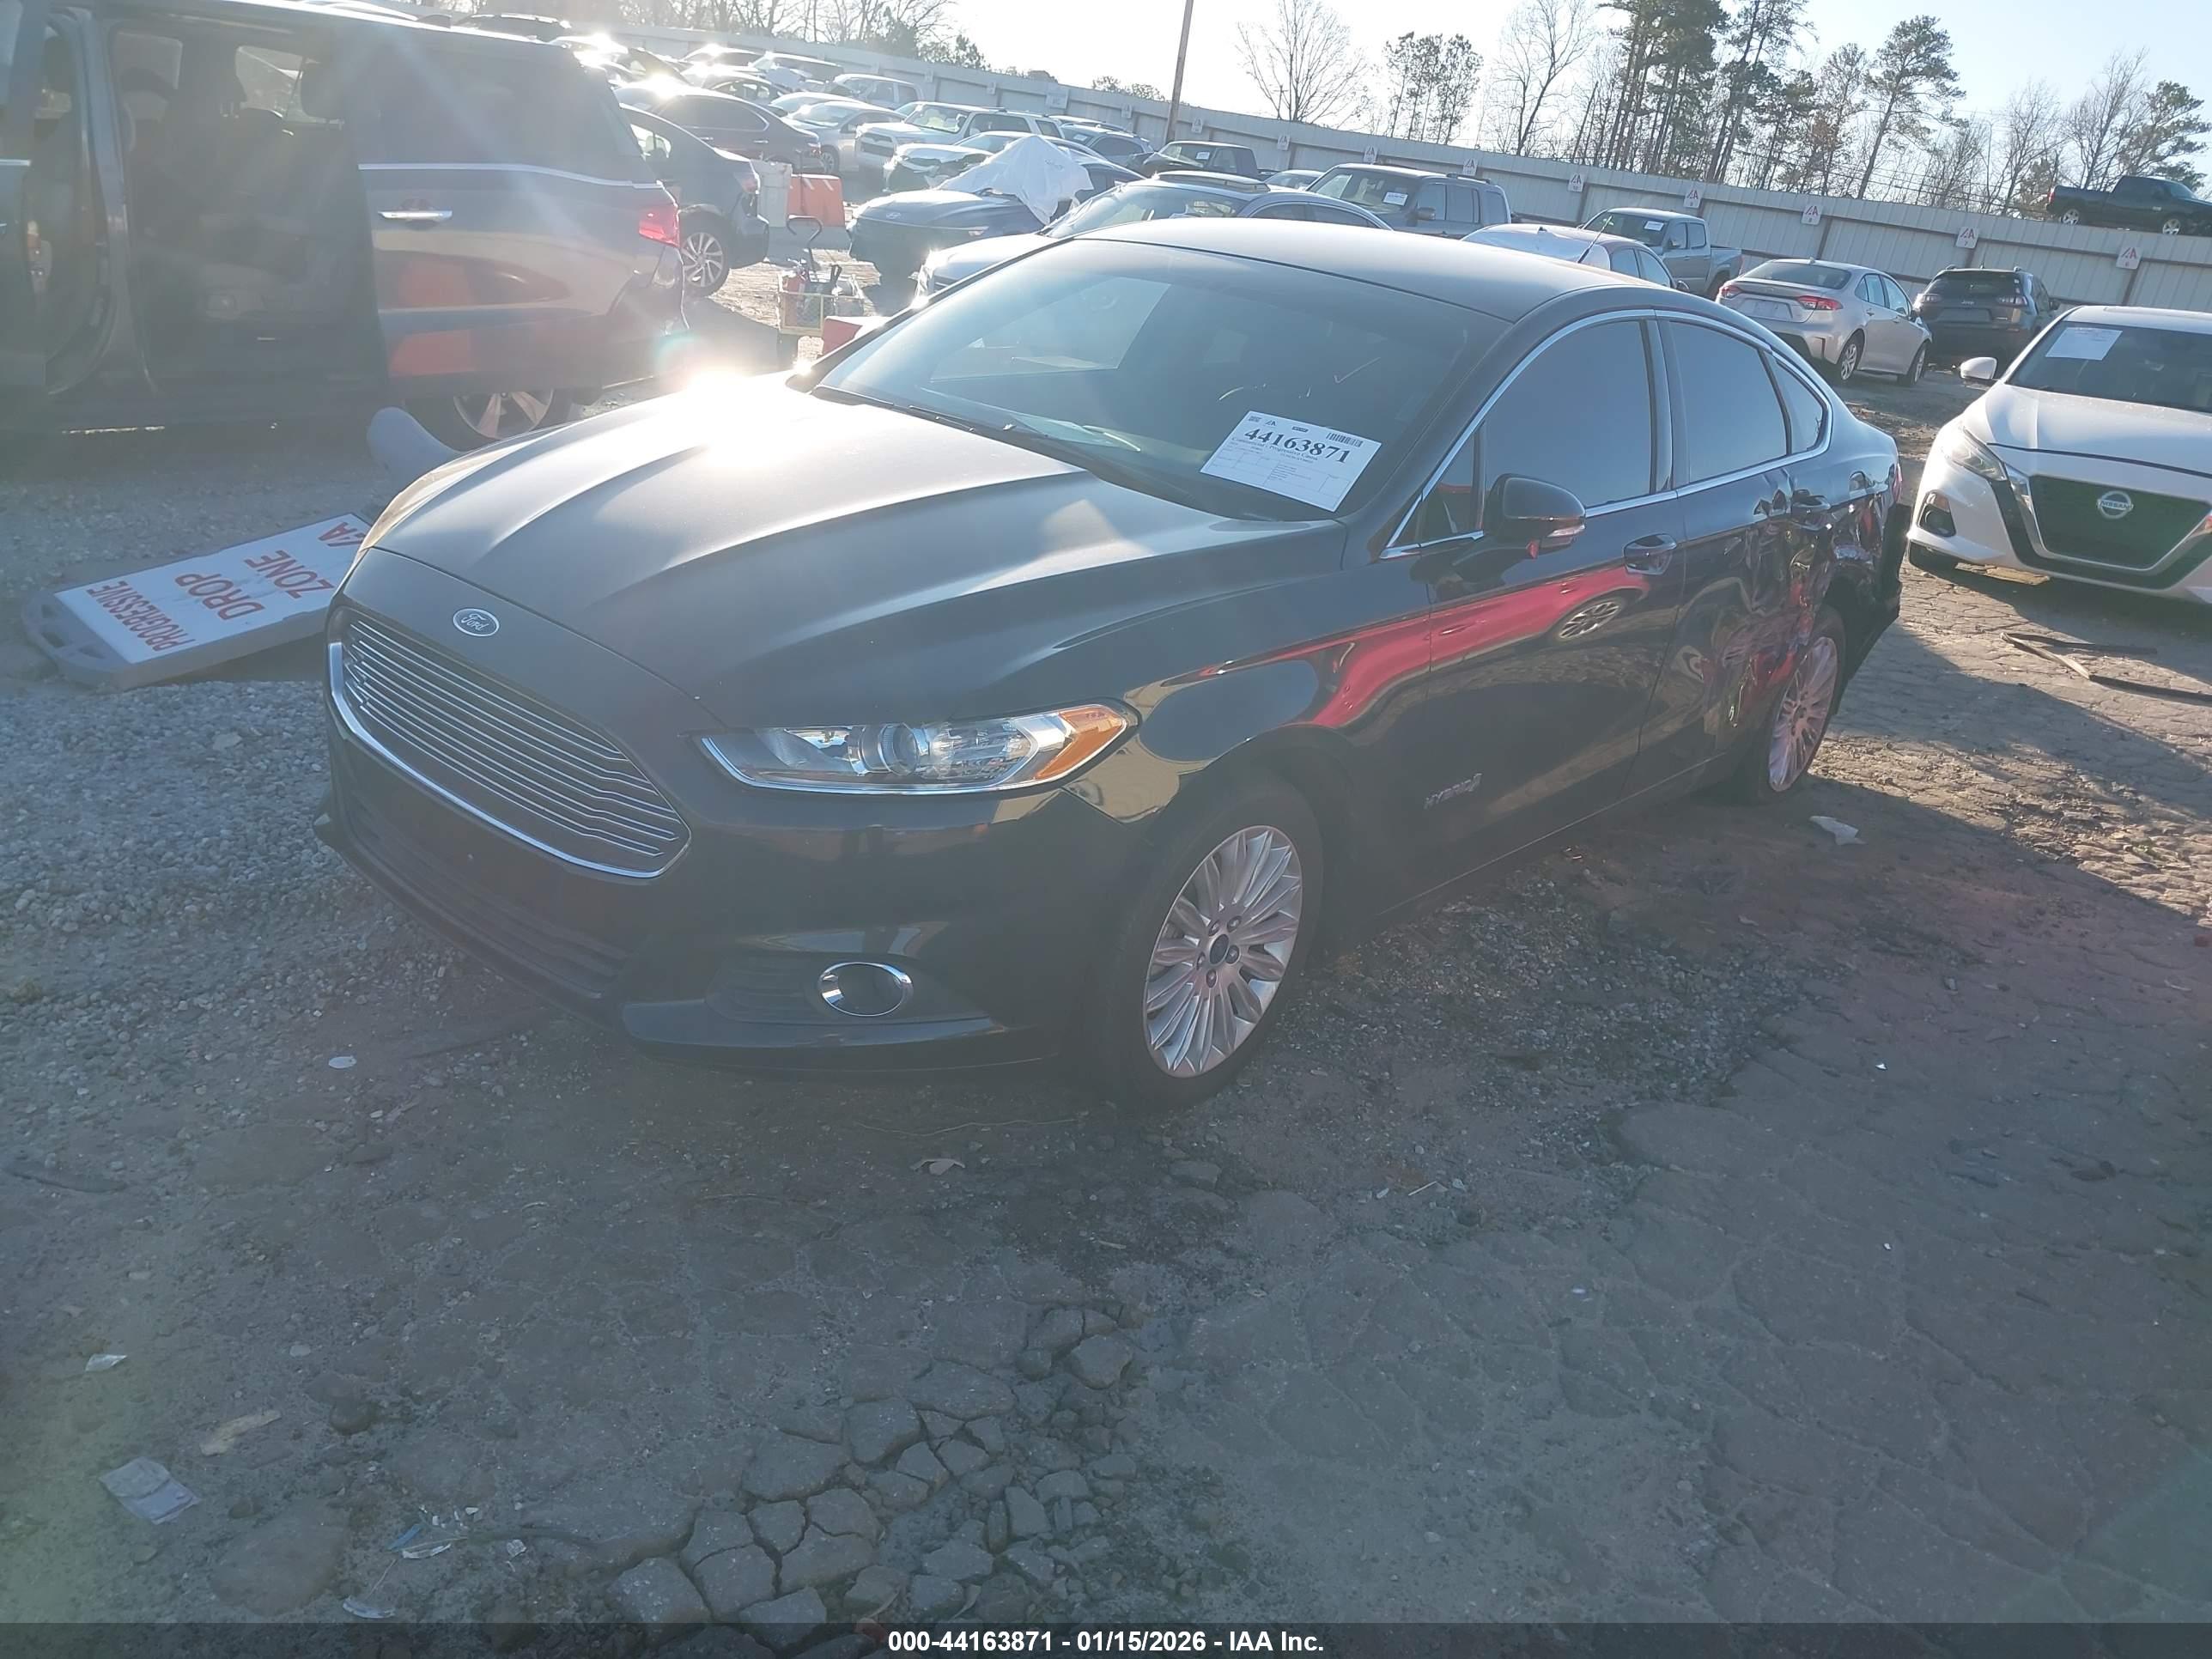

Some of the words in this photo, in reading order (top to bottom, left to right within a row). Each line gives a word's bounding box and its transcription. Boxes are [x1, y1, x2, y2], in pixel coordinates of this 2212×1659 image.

[1244, 428, 1351, 464] 44163871
[2100, 500, 2130, 510] NISSAN
[244, 550, 335, 599] ZONE
[86, 580, 196, 652] PROGRESSIVE
[174, 573, 266, 621] DROP
[460, 612, 489, 631] Ford
